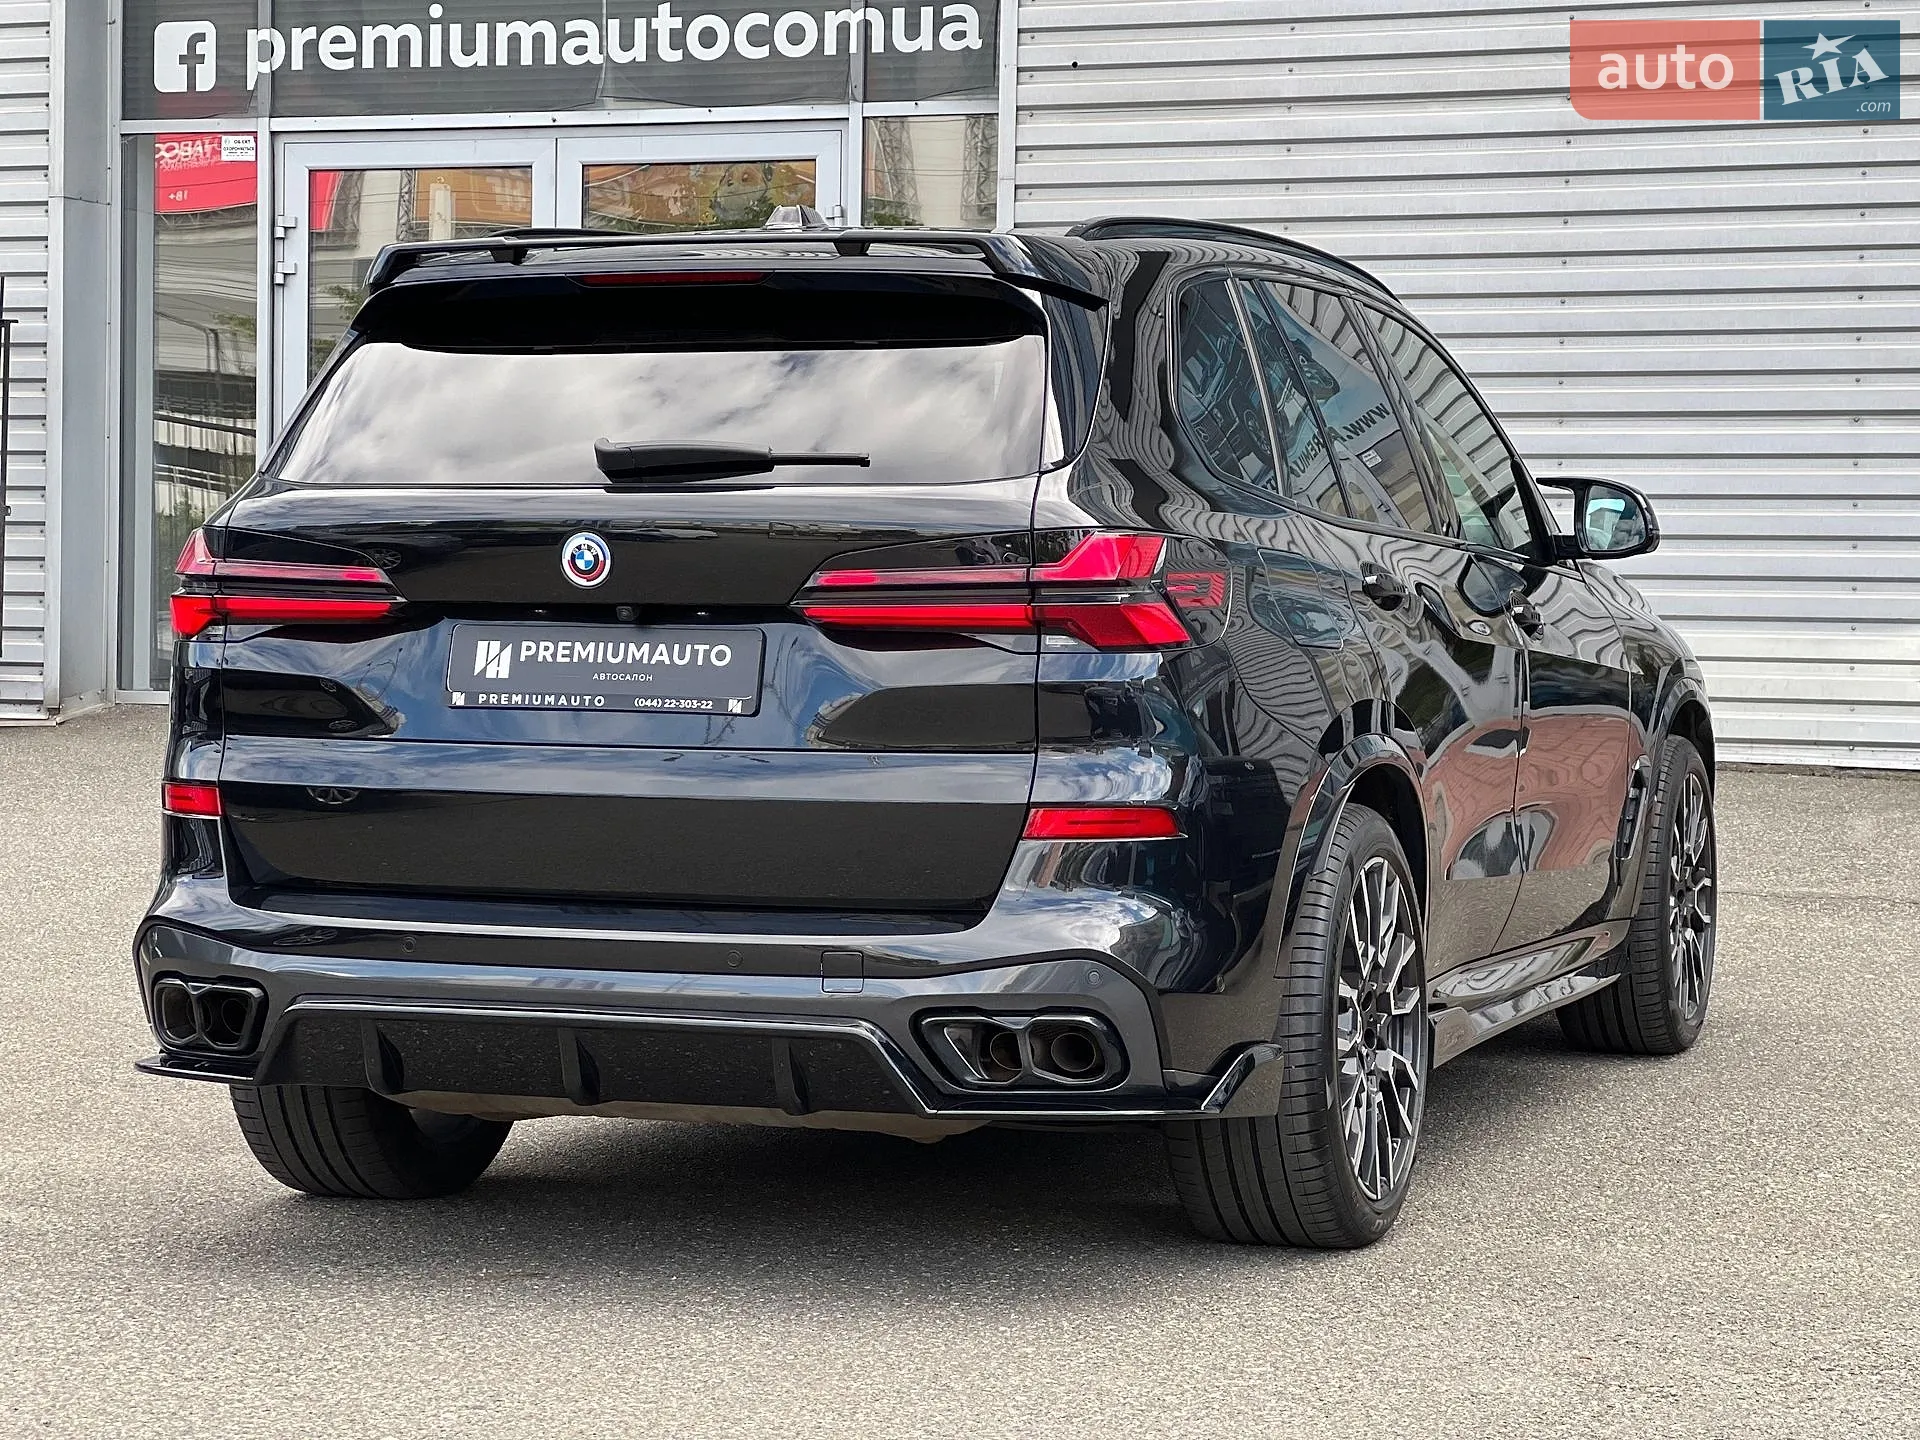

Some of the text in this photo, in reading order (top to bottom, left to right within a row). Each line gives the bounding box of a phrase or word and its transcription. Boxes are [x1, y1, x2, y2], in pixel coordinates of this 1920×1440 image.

[247, 1, 983, 91] premiumautocomua
[572, 543, 598, 556] BMW
[520, 640, 732, 667] PREMIUMAUTO
[592, 673, 654, 682] АВТОСАЛОН
[478, 693, 713, 709] PREMIUMAUTO (044) 22-303-22
